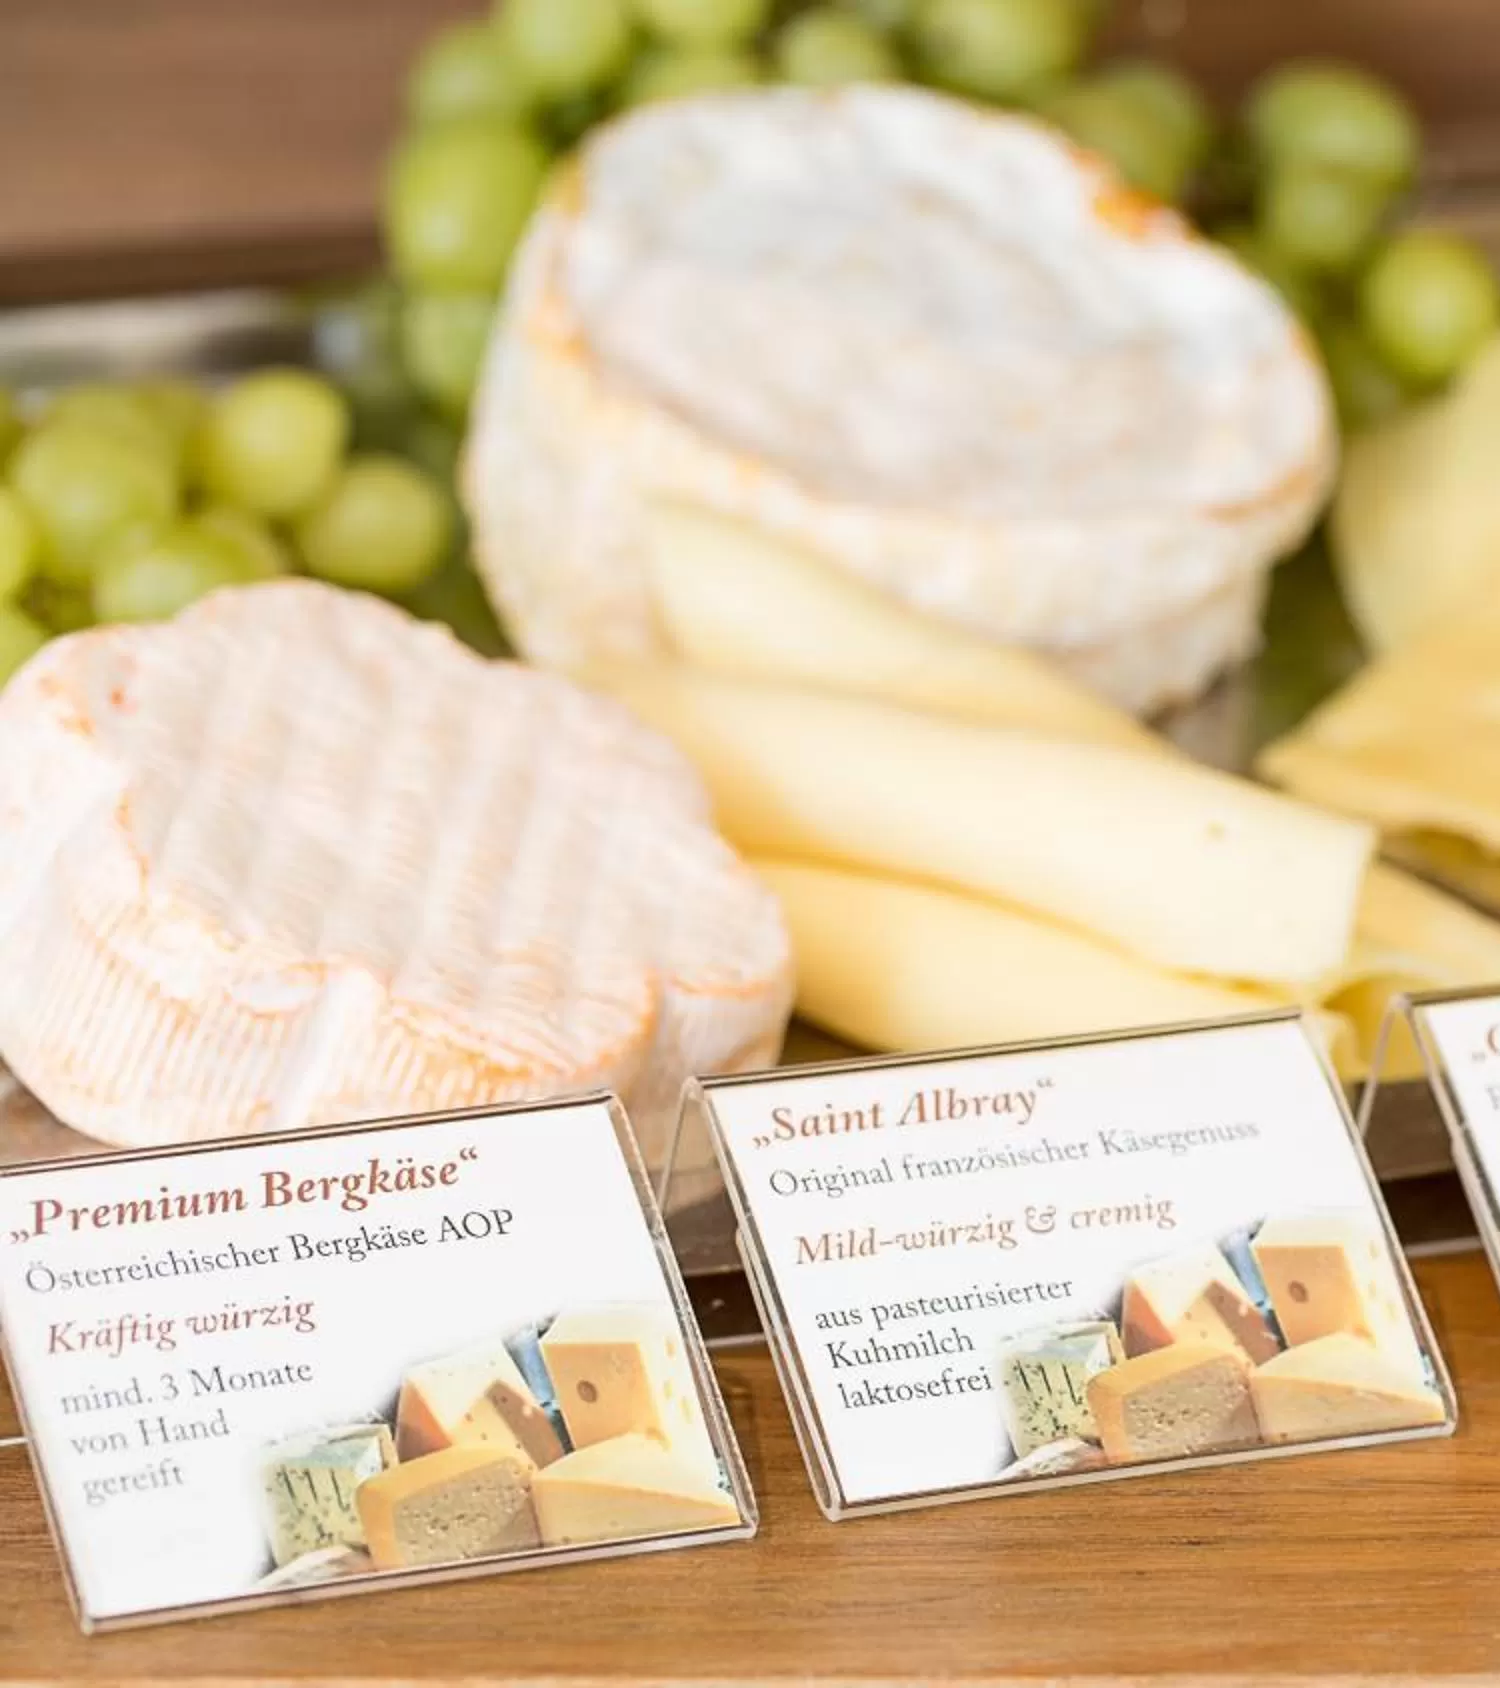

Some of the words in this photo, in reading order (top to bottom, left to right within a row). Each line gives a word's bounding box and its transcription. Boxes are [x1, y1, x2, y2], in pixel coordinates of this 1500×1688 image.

[752, 1101, 885, 1149] „Saint
[896, 1076, 1054, 1130] Albray“
[770, 1158, 894, 1201] Original
[903, 1138, 1090, 1186] französischer
[1097, 1119, 1261, 1159] Käsegenuss
[10, 1182, 247, 1245] „Premium
[261, 1146, 479, 1213] Bergkäse“
[26, 1240, 280, 1293] Österreichischer
[288, 1221, 428, 1265] Bergkäse
[438, 1208, 516, 1242] AOP
[794, 1216, 1018, 1266] Mild-würzig
[1024, 1205, 1059, 1235] &
[1070, 1195, 1177, 1229] cremig
[47, 1304, 177, 1358] Kräftig
[185, 1296, 316, 1333] würzig
[815, 1306, 863, 1331] aus
[871, 1274, 1074, 1334] pasteurisierter
[826, 1327, 974, 1370] Kuhmilch
[60, 1377, 153, 1415] mind.
[161, 1371, 179, 1402] 3
[188, 1359, 314, 1397] Monate
[838, 1366, 992, 1411] laktosefrei
[70, 1430, 129, 1457] von
[139, 1410, 230, 1449] Hand
[82, 1461, 184, 1505] gereift
